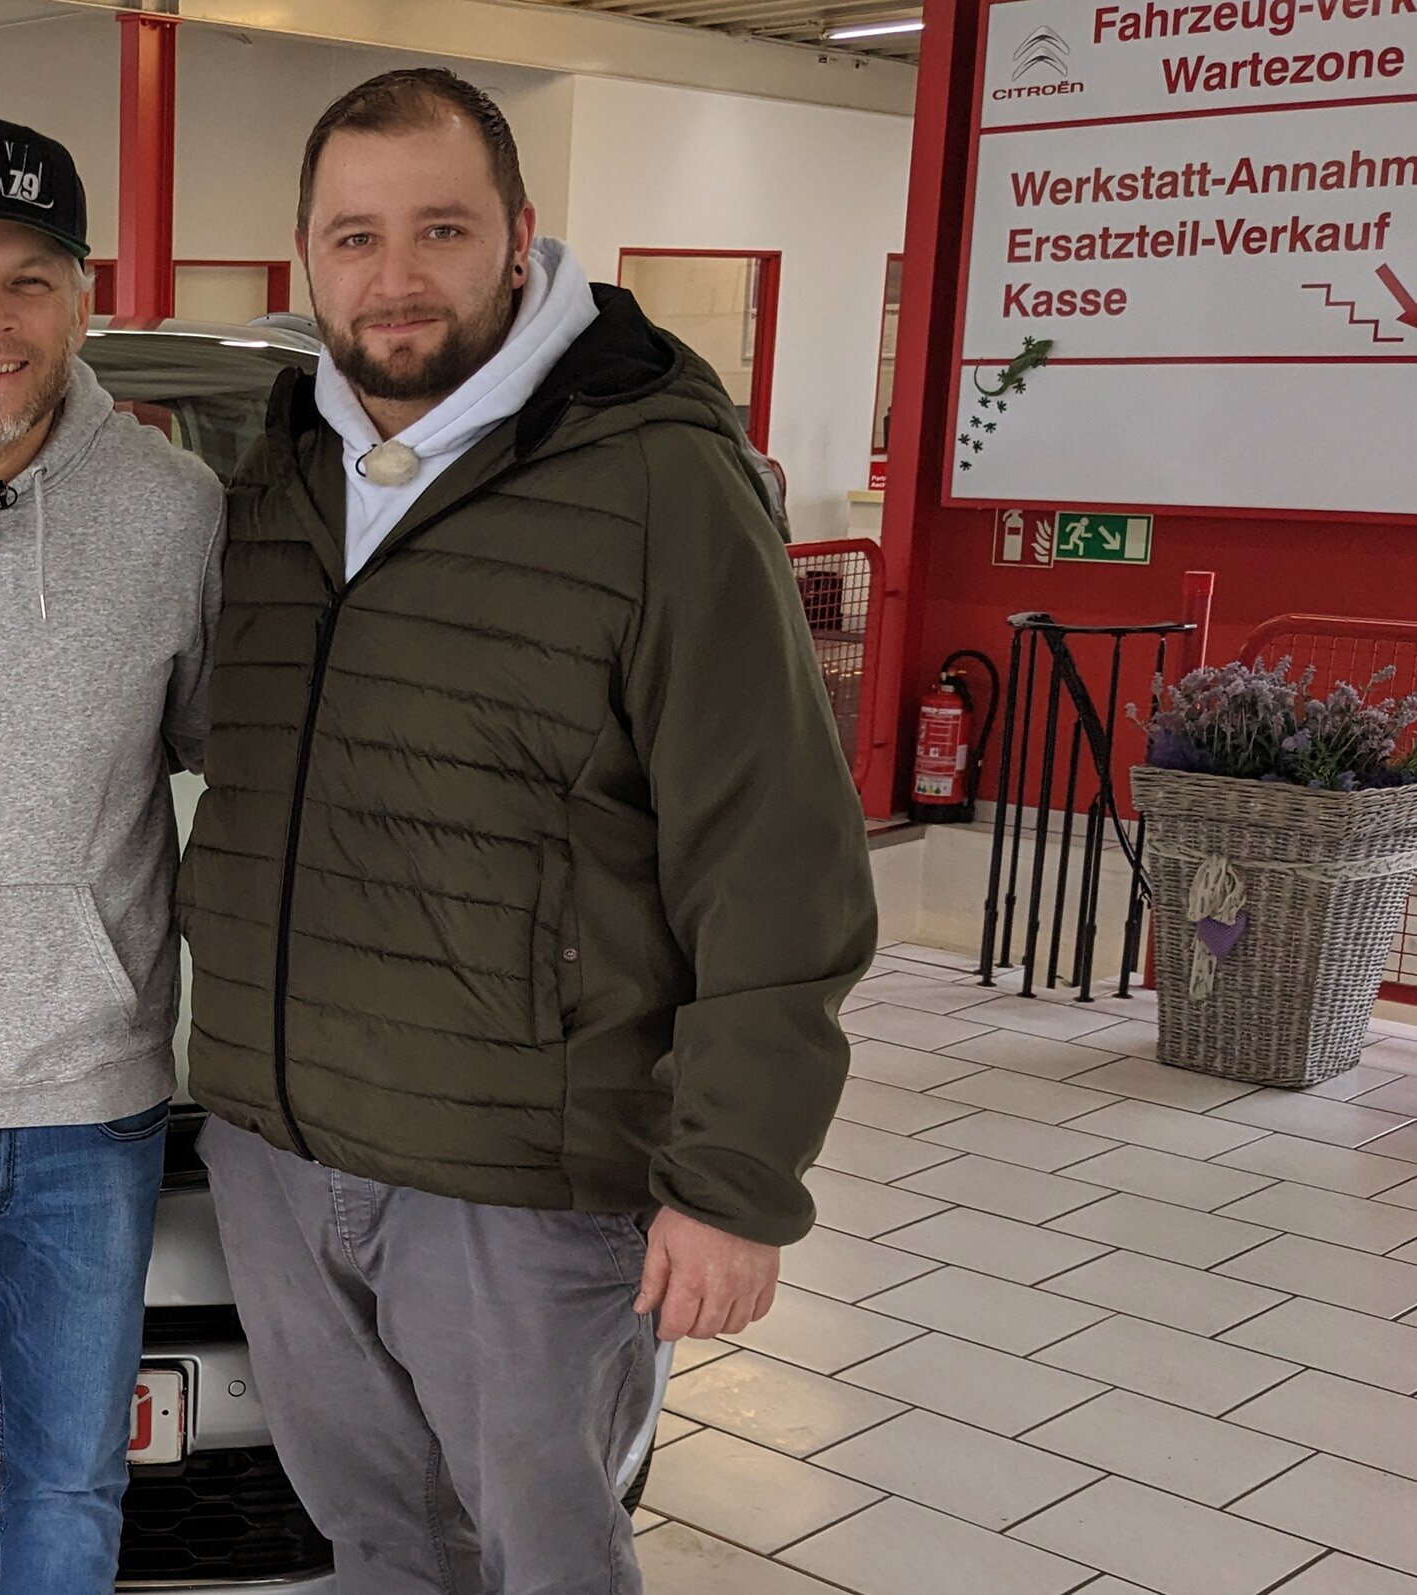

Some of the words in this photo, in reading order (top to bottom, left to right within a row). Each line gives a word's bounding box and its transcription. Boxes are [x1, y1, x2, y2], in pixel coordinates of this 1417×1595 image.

[1162, 46, 1405, 95] Wartezone
[9, 169, 40, 201] 79
[1010, 150, 1417, 208] Werkstatt-Annahm
[1007, 212, 1392, 263] Ersatzteil-Verkauf
[1003, 283, 1127, 318] Kasse
